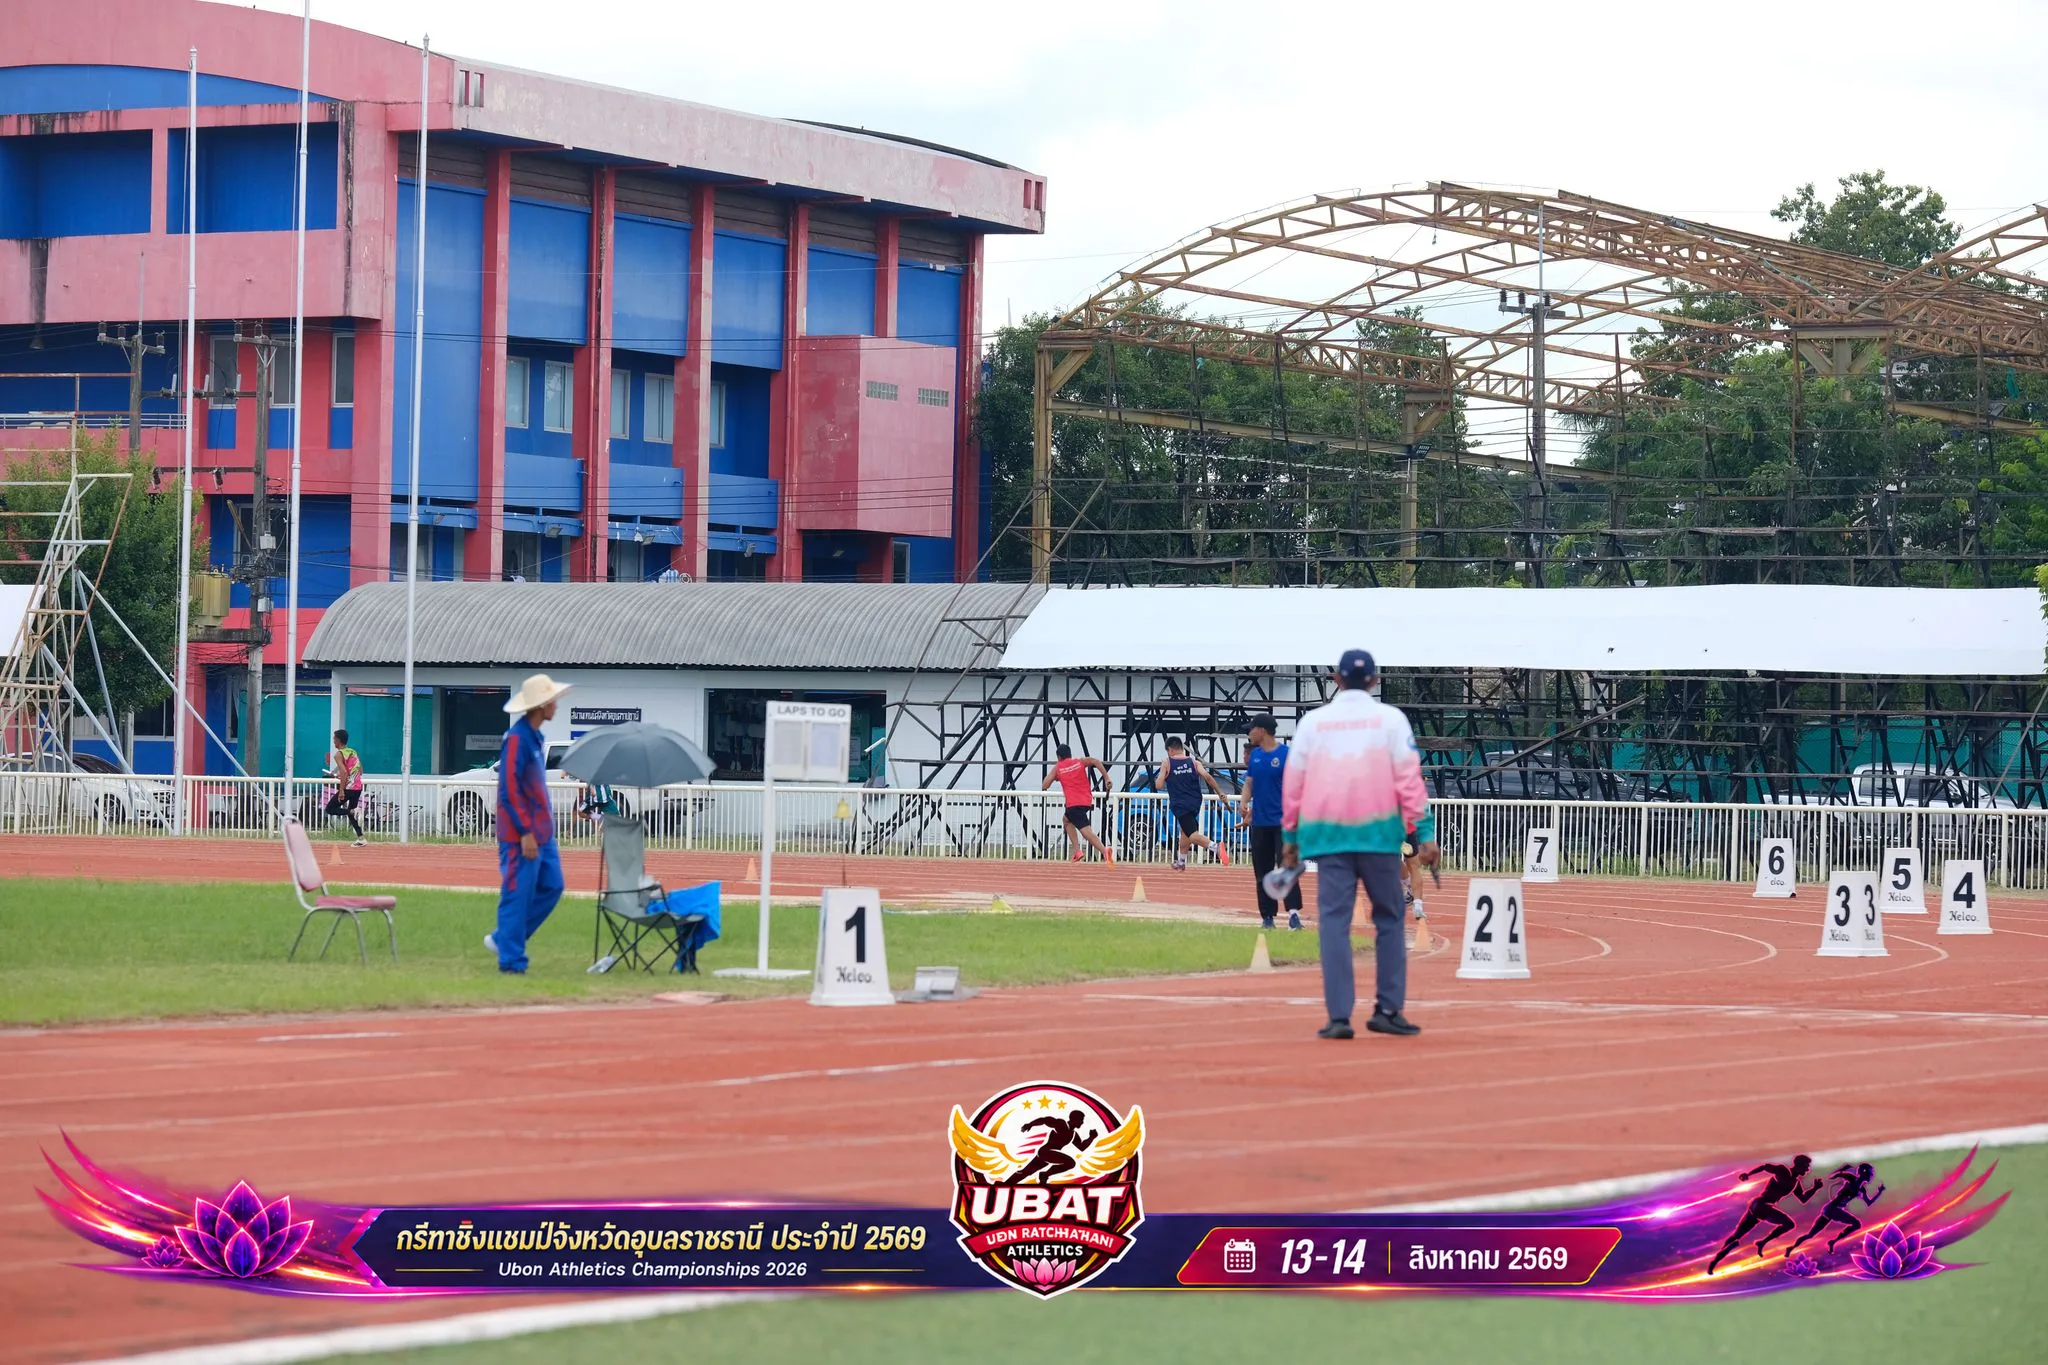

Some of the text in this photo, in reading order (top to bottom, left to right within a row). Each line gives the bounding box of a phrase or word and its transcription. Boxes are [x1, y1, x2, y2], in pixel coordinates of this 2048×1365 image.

[777, 706, 846, 718] LAPS TO GO
[1533, 836, 1549, 864] 7
[1768, 845, 1785, 875] 6
[1892, 857, 1911, 890] 5
[1953, 871, 1976, 908] 4
[1474, 895, 1493, 942] 2
[1507, 895, 1519, 943] 2
[1834, 884, 1850, 927] 3
[1864, 884, 1875, 926] 3
[845, 906, 866, 963] 1
